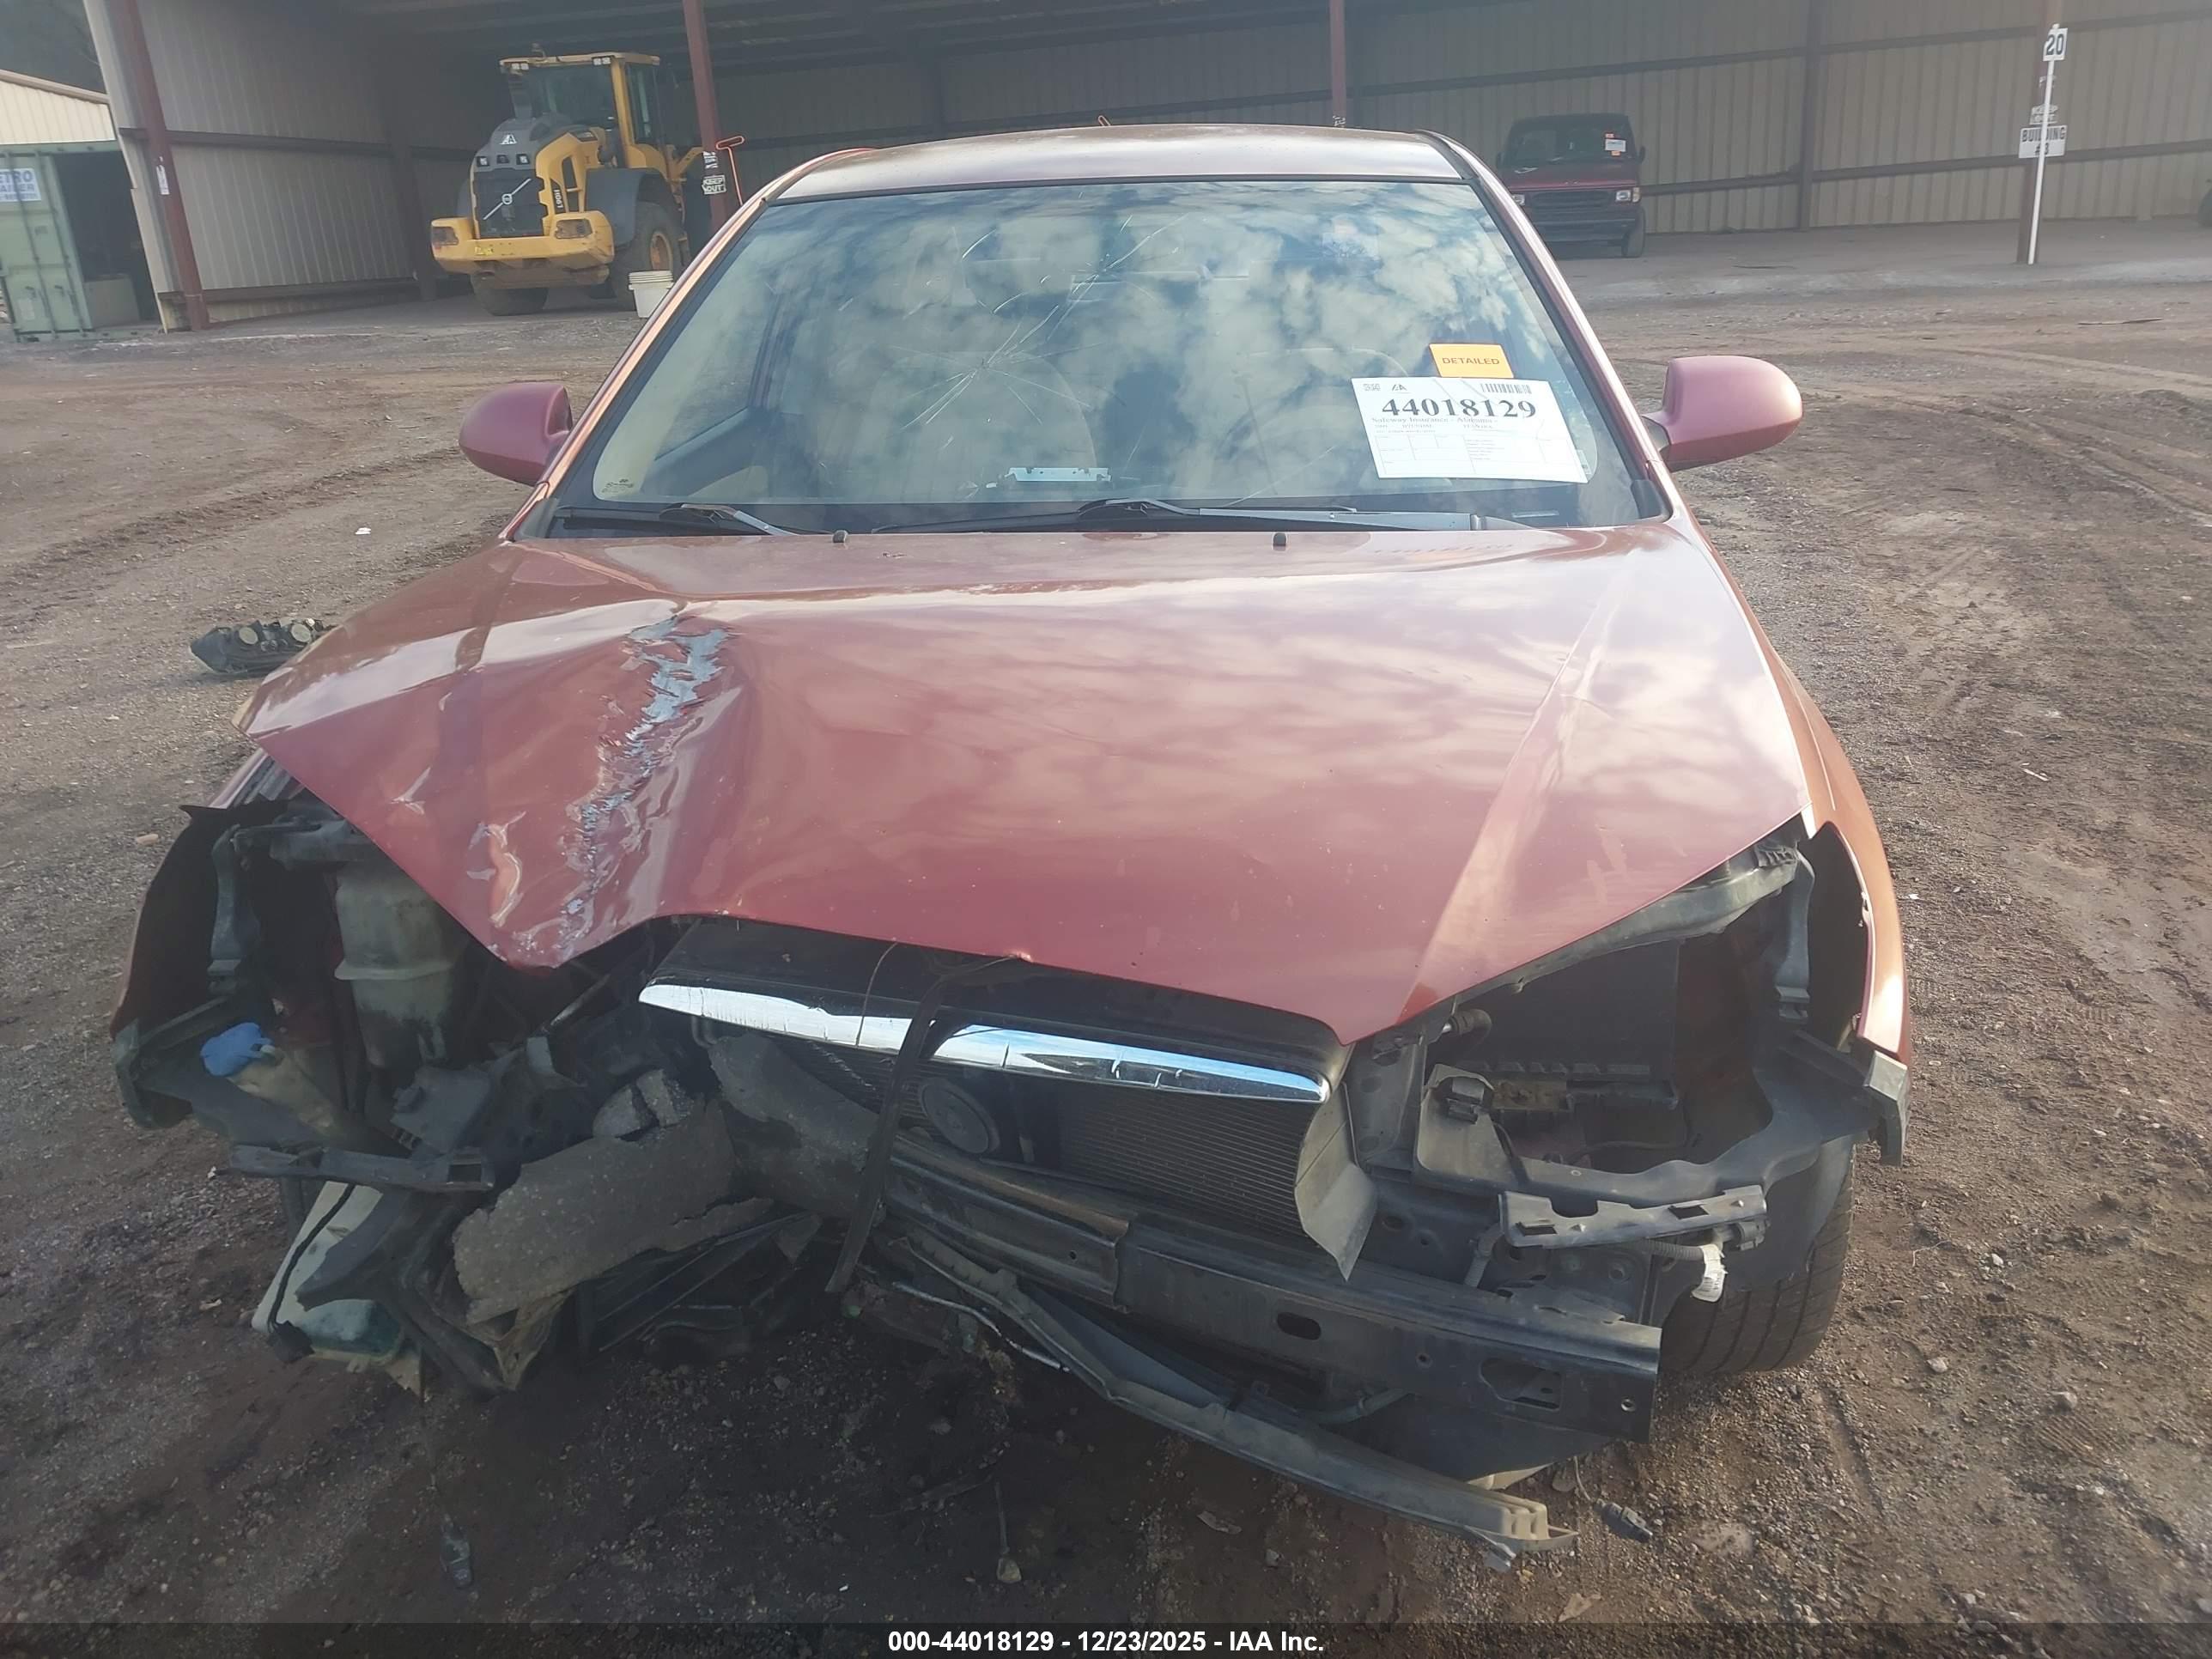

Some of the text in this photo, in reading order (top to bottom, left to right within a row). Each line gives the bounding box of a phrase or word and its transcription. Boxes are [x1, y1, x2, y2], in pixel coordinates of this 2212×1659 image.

[2045, 33, 2064, 56] 20
[2021, 126, 2065, 143] BUILING
[1442, 356, 1500, 365] DETAILED
[1382, 398, 1536, 418] 44018129
